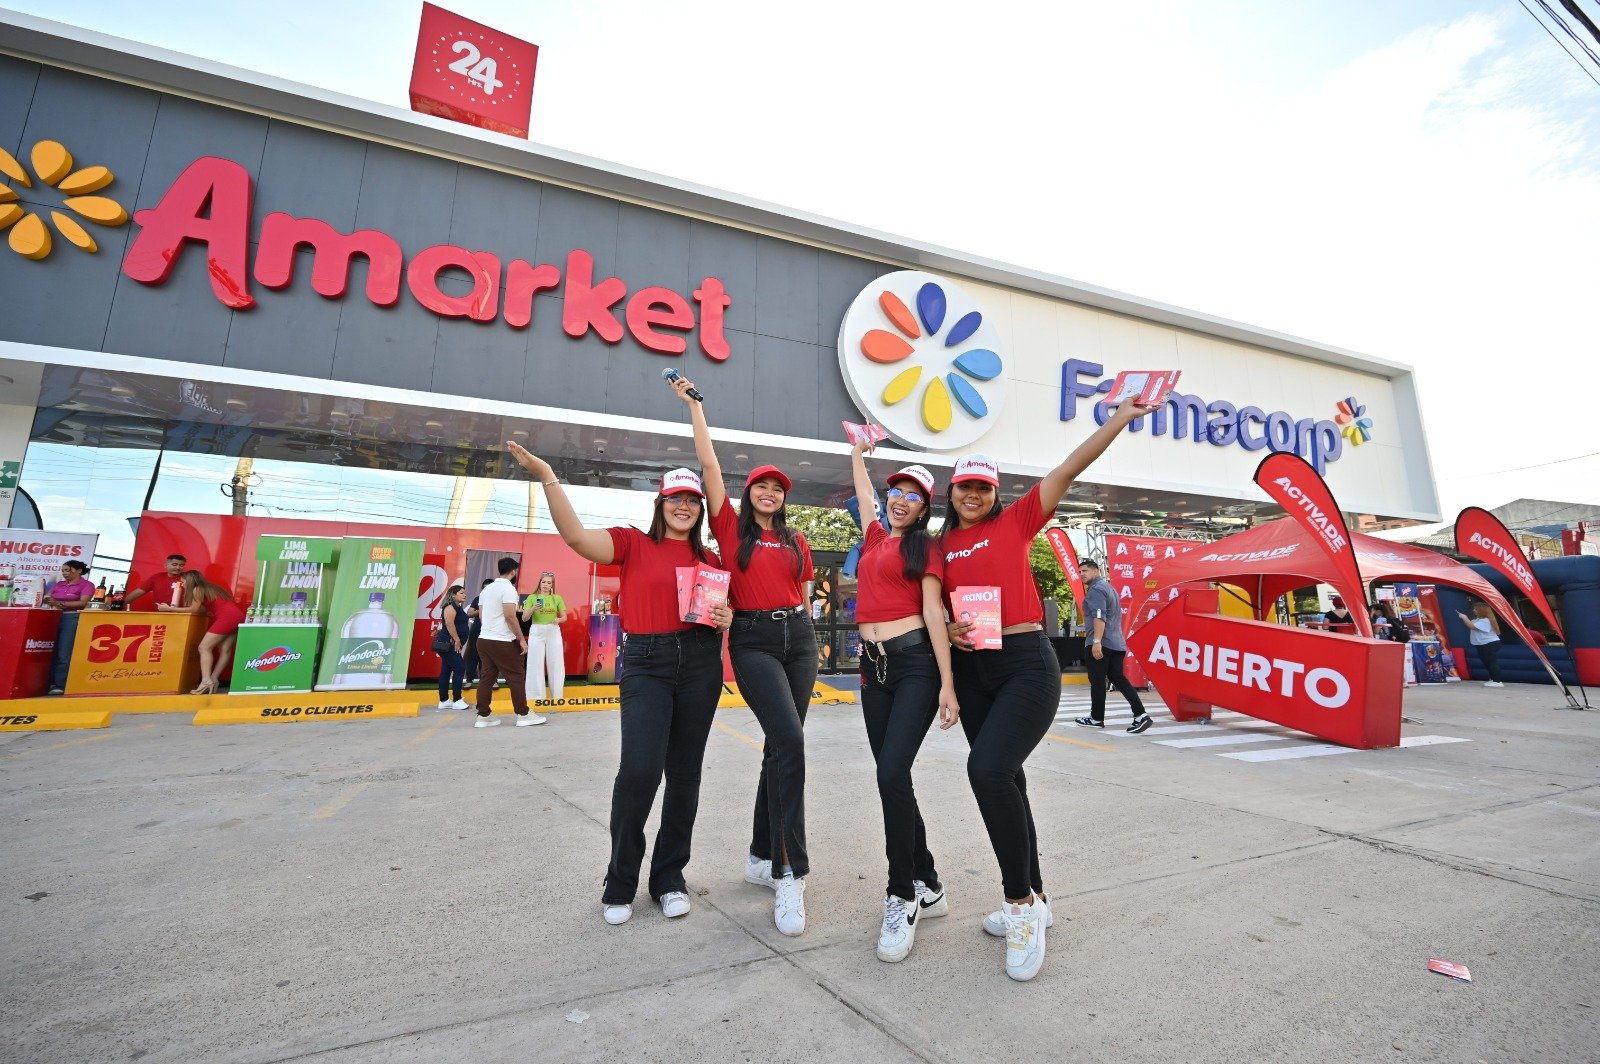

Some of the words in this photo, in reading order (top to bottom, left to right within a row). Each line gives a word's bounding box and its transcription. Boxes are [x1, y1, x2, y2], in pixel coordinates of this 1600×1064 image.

[448, 40, 504, 95] 24
[467, 78, 484, 89] Hrs.
[121, 155, 731, 362] Amarket
[1060, 358, 1343, 477] Fmacorp
[966, 460, 995, 473] Amarket
[1272, 476, 1347, 550] ACTIVADE
[0, 540, 82, 558] HUGGIES
[284, 540, 307, 550] LIMA
[1199, 544, 1300, 562] ACTIVADE
[1051, 532, 1080, 581] ACTIVADE
[1468, 532, 1534, 586] ACTIVADE
[287, 562, 318, 575] LIMA
[367, 562, 397, 576] LIMA
[359, 574, 400, 590] LIMÓN
[87, 623, 152, 664] 37
[148, 624, 167, 663] LENGUAS
[244, 651, 302, 671] Mendocina
[338, 647, 392, 666] Mendocina
[1147, 634, 1351, 709] ABIERTO
[261, 707, 301, 717] SOLO
[304, 704, 374, 716] CLIENTES
[534, 698, 567, 707] SOLO
[571, 696, 621, 706] CLIENTES
